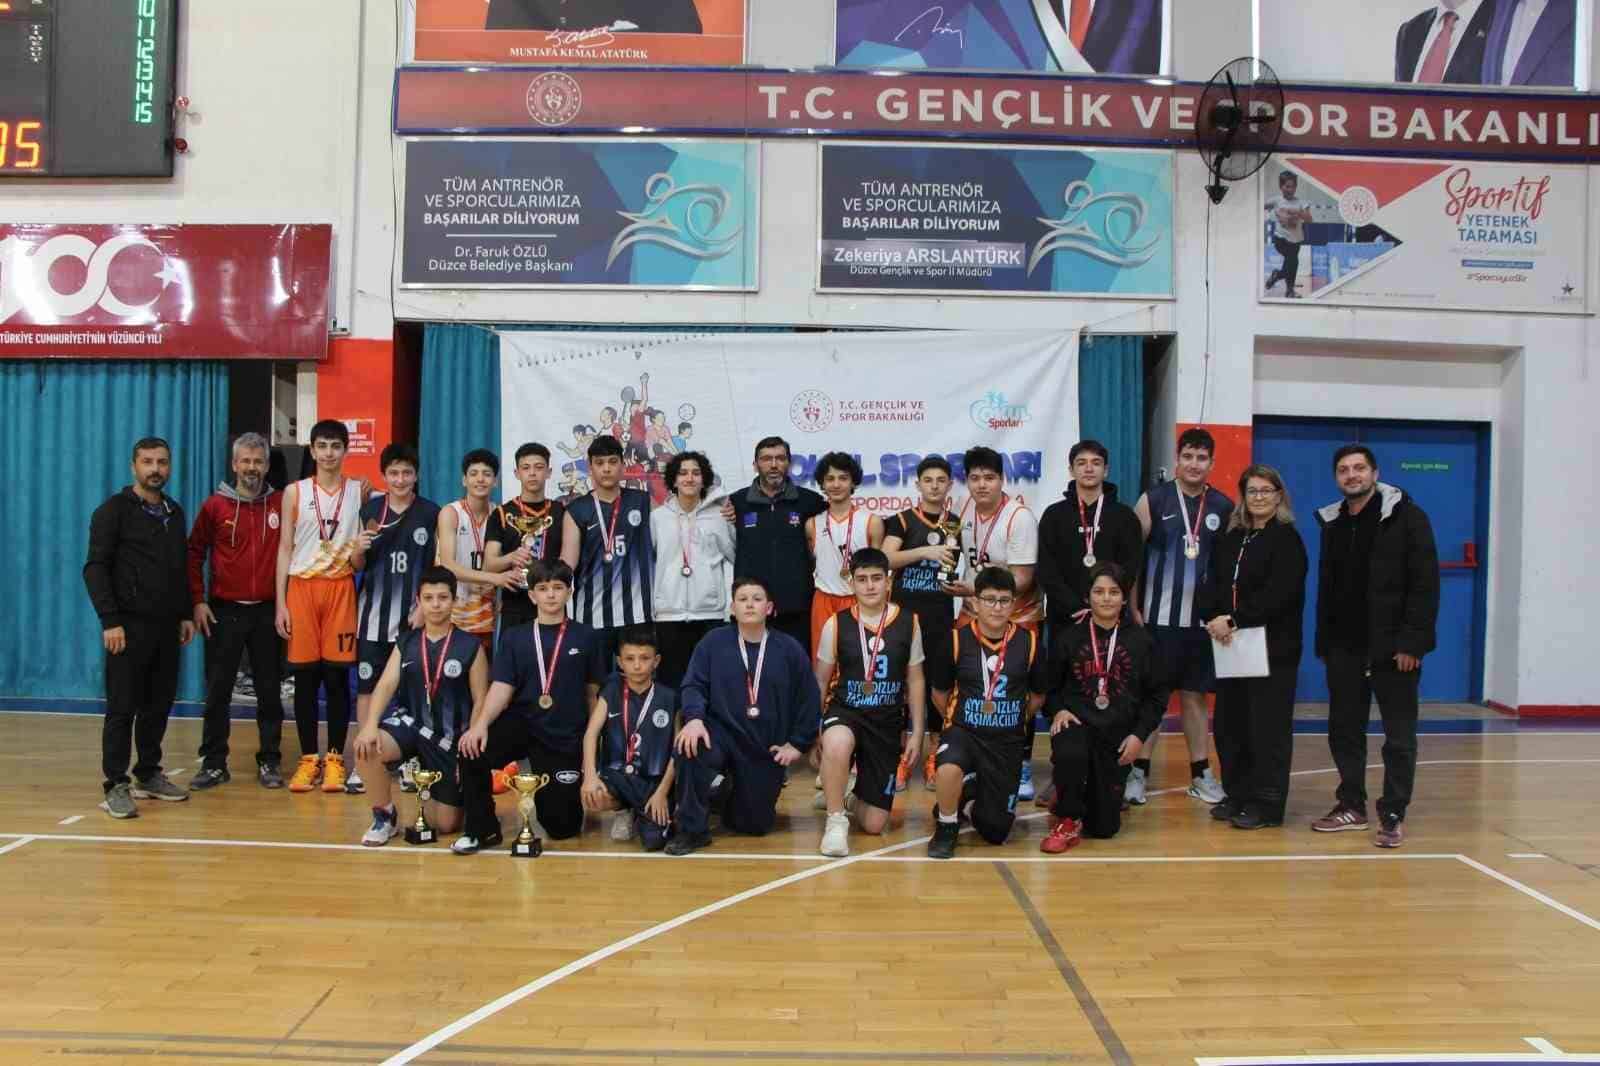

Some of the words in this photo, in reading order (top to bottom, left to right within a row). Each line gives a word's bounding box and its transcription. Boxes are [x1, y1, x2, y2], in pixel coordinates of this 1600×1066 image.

[137, 19, 155, 37] 11
[137, 39, 154, 59] 12
[510, 47, 558, 57] MUSTAFA
[560, 48, 598, 58] KEMAL
[600, 48, 648, 59] ATATÜRK
[136, 60, 153, 80] 13
[136, 81, 153, 101] 14
[135, 102, 152, 123] 15
[758, 85, 853, 121] T.C.
[876, 85, 1112, 129] GENÇLİK
[1131, 95, 1195, 130] VE
[1369, 105, 1599, 147] BAKANLI
[443, 176, 476, 192] TÜM
[481, 176, 564, 192] ANTRENÖR
[861, 181, 895, 196] TÜM
[900, 182, 983, 198] ANTRENÖR
[424, 194, 443, 208] VE
[447, 194, 581, 208] SPORCULARIMIZA
[1445, 167, 1551, 225] Sportif
[842, 198, 862, 212] VE
[865, 198, 1001, 214] SPORCULARIMIZA
[423, 212, 499, 227] BAŞARILAR
[503, 211, 580, 225] DİLİYORUM
[842, 216, 919, 231] BAŞARILAR
[923, 216, 1000, 231] DİLİYORUM
[1466, 214, 1529, 228] YETENEK
[1457, 228, 1537, 244] TARAMASI
[455, 246, 473, 257] Dr.
[475, 246, 510, 257] Faruk
[513, 244, 547, 257] ÖZLÜ
[834, 248, 902, 266] Zekeriya
[905, 248, 1021, 265] ARSLANTÜRK
[428, 259, 467, 271] Düzce
[470, 259, 522, 273] Belediye
[525, 260, 573, 273] Başkanı
[850, 264, 878, 274] Düzce
[880, 265, 911, 277] Gençlik
[914, 267, 925, 275] ve
[926, 266, 947, 277] Spor
[0, 331, 34, 344] TÜRKİYE
[35, 331, 106, 344] CUMHURİYETİ'NİN
[108, 331, 145, 344] YÜZÜNCÜ
[147, 333, 162, 344] YILI
[840, 400, 858, 409] T.C.
[861, 400, 906, 411] GENÇLİK
[911, 400, 924, 409] VE
[840, 412, 866, 421] SPOR
[869, 411, 924, 421] BAKANLIĞI
[390, 551, 408, 574] 18
[338, 633, 356, 652] 17
